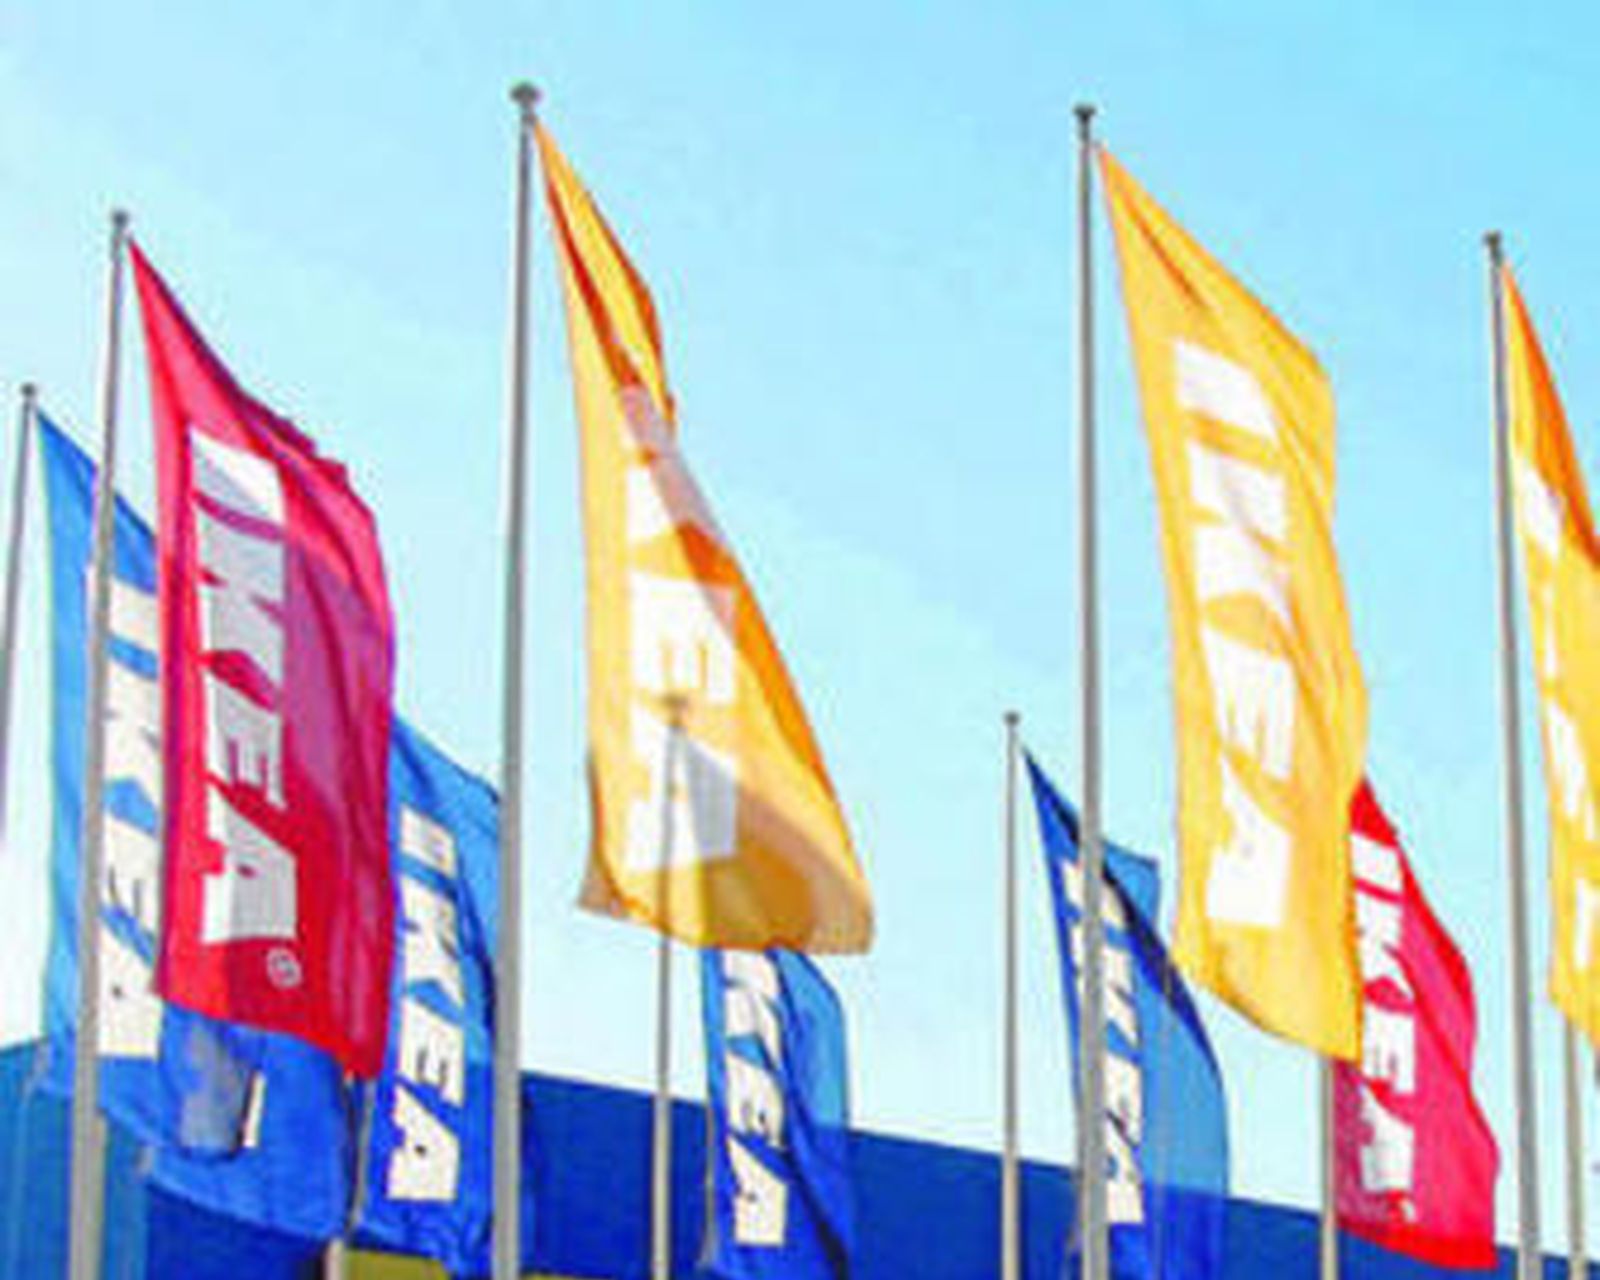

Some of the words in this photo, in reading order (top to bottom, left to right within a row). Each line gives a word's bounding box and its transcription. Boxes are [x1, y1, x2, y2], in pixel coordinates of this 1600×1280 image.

[190, 427, 298, 945] IKEA
[1174, 338, 1300, 928] IKEA
[386, 804, 466, 1201] IKEA
[724, 951, 790, 1245] KEA
[1350, 830, 1416, 1193] IKEA
